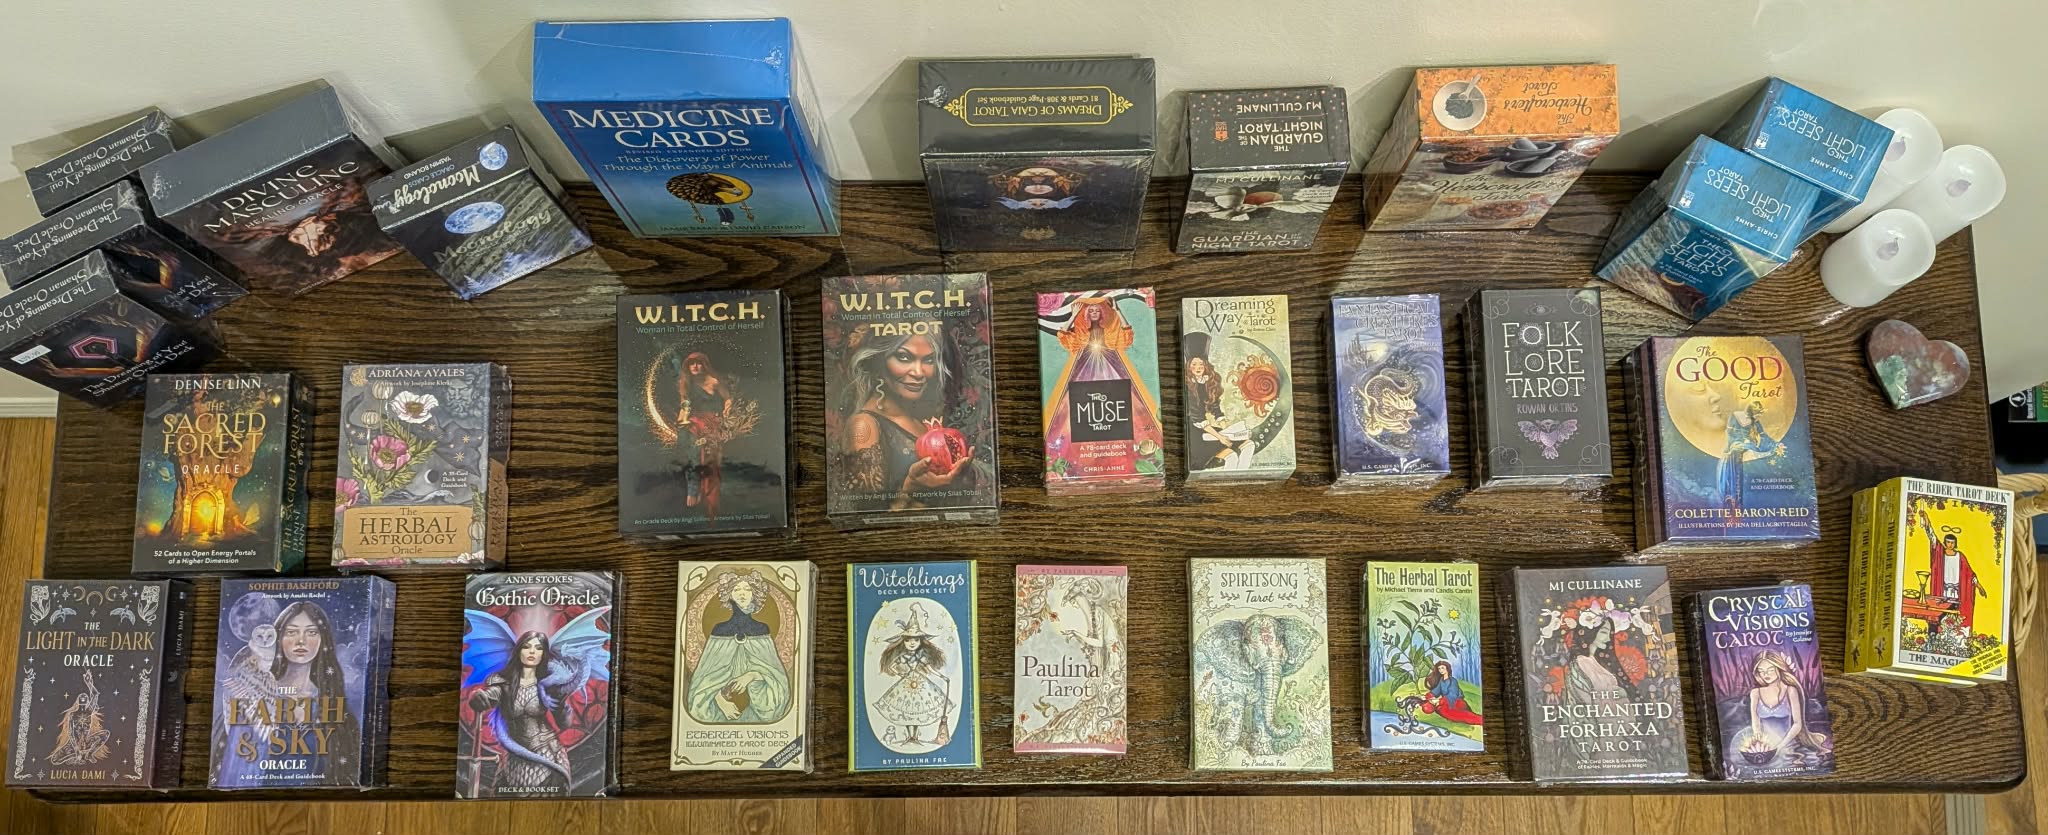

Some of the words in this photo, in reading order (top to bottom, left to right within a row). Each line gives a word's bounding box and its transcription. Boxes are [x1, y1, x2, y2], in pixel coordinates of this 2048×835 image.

[973, 107, 1008, 116] TAROT
[1011, 106, 1037, 116] GAIA
[1040, 106, 1055, 115] OF
[1058, 105, 1102, 115] DREAMS
[1237, 103, 1302, 113] CULLINANE
[1306, 102, 1322, 110] MJ
[1504, 95, 1593, 116] Herbcrafter's
[564, 108, 774, 128] MEDICINE
[1557, 113, 1574, 125] The
[1238, 123, 1279, 133] TAROT
[1283, 122, 1323, 131] NIGHT
[109, 126, 148, 150] Shaman
[615, 129, 750, 148] CARDS
[1251, 133, 1323, 145] GUARDIAN
[132, 140, 155, 153] The
[75, 147, 107, 167] Oracle
[85, 149, 131, 174] Dreaming
[429, 156, 452, 169] YASMIN
[646, 155, 710, 164] Discovery
[46, 162, 73, 181] Deck
[404, 165, 429, 180] BOLAND
[603, 164, 658, 173] Through
[661, 163, 682, 171] the
[685, 163, 719, 171] Ways
[740, 161, 793, 169] Animals
[1718, 167, 1743, 181] TAROT
[393, 164, 481, 205] Moonology
[245, 204, 296, 229] HEALING
[298, 183, 344, 205] ORACLE
[1747, 191, 1791, 220] LIGHT
[840, 289, 971, 312] W.I.T.C.H.
[635, 301, 765, 324] W.I.T.C.H.
[841, 313, 872, 321] Woman
[882, 311, 901, 320] Total
[903, 310, 932, 319] Control
[934, 309, 942, 318] of
[943, 309, 970, 317] Herself
[1195, 298, 1275, 319] Dreaming
[870, 321, 943, 337] TAROT
[1203, 314, 1243, 333] Way
[1248, 315, 1276, 326] Tarot
[1355, 315, 1439, 329] CREATURES
[1384, 328, 1425, 341] TAROT
[1502, 321, 1583, 347] FOLK
[1697, 346, 1718, 358] The
[1505, 349, 1584, 376] LORE
[1676, 356, 1783, 382] GOOD
[369, 369, 422, 378] ADRIANA
[424, 369, 465, 377] AYALES
[175, 379, 222, 390] DENISE
[228, 379, 261, 389] LINN
[1505, 377, 1585, 398] TAROT
[1740, 382, 1782, 400] Tarot
[1087, 393, 1107, 401] THE
[207, 402, 224, 411] THE
[1077, 401, 1128, 423] MUSE
[1517, 403, 1546, 414] ROWAN
[162, 413, 266, 437] SACRED
[1089, 423, 1111, 431] TAROT
[164, 433, 264, 459] FOREST
[1093, 450, 1127, 458] guidebook
[182, 464, 240, 474] ORACLE
[1084, 465, 1125, 473] CHRIS-ANNE
[1907, 480, 1924, 491] THE
[1927, 482, 1952, 496] RIDER
[1955, 486, 1982, 499] TAROT
[400, 507, 417, 516] The
[1675, 509, 1730, 518] COLETTE
[1735, 508, 1809, 518] BARON-REID
[360, 517, 457, 534] HERBAL
[360, 534, 457, 545] ASTROLOGY
[192, 550, 209, 558] Open
[211, 550, 233, 558] Energy
[392, 545, 423, 554] Oracle
[505, 576, 534, 584] ANNE
[536, 575, 573, 583] STOKES
[859, 567, 964, 593] Witchlings
[1221, 572, 1298, 590] SPIRITSONG
[1374, 568, 1395, 585] The
[1400, 568, 1437, 586] Herbal
[1441, 569, 1472, 587] Tarot
[249, 582, 285, 591] SOPHIE
[287, 582, 339, 590] BASHFORD
[1550, 582, 1564, 591] MJ
[1568, 579, 1642, 590] CULLINANE
[476, 587, 536, 606] Gothic
[541, 586, 600, 606] Oracle
[1245, 590, 1274, 604] Tarot
[1708, 589, 1808, 622] CRYSTAL
[84, 622, 100, 630] THE
[1726, 612, 1810, 631] VISIONS
[26, 631, 75, 650] LIGHT
[77, 636, 89, 647] IN
[90, 636, 108, 647] THE
[110, 631, 155, 650] DARK
[1713, 629, 1784, 648] TAROT
[64, 654, 114, 667] ORACLE
[1909, 653, 1928, 662] THE
[1022, 655, 1100, 678] Paulina
[1041, 680, 1091, 697] Tarot
[1590, 690, 1620, 699] THE
[230, 696, 346, 725] EARTH
[1542, 703, 1673, 722] ENCHANTED
[686, 730, 743, 739] ETHEREAL
[747, 730, 789, 739] VISIONS
[1559, 720, 1659, 738] FÖRHÄXA
[237, 731, 258, 762] &
[268, 727, 335, 756] SKY
[686, 740, 736, 748] ILLUMINATED
[1579, 740, 1642, 753] TAROT
[772, 742, 797, 763] EXPANDED
[260, 760, 307, 770] ORACLE
[51, 770, 78, 779] LUCIA
[82, 770, 105, 780] DAMI
